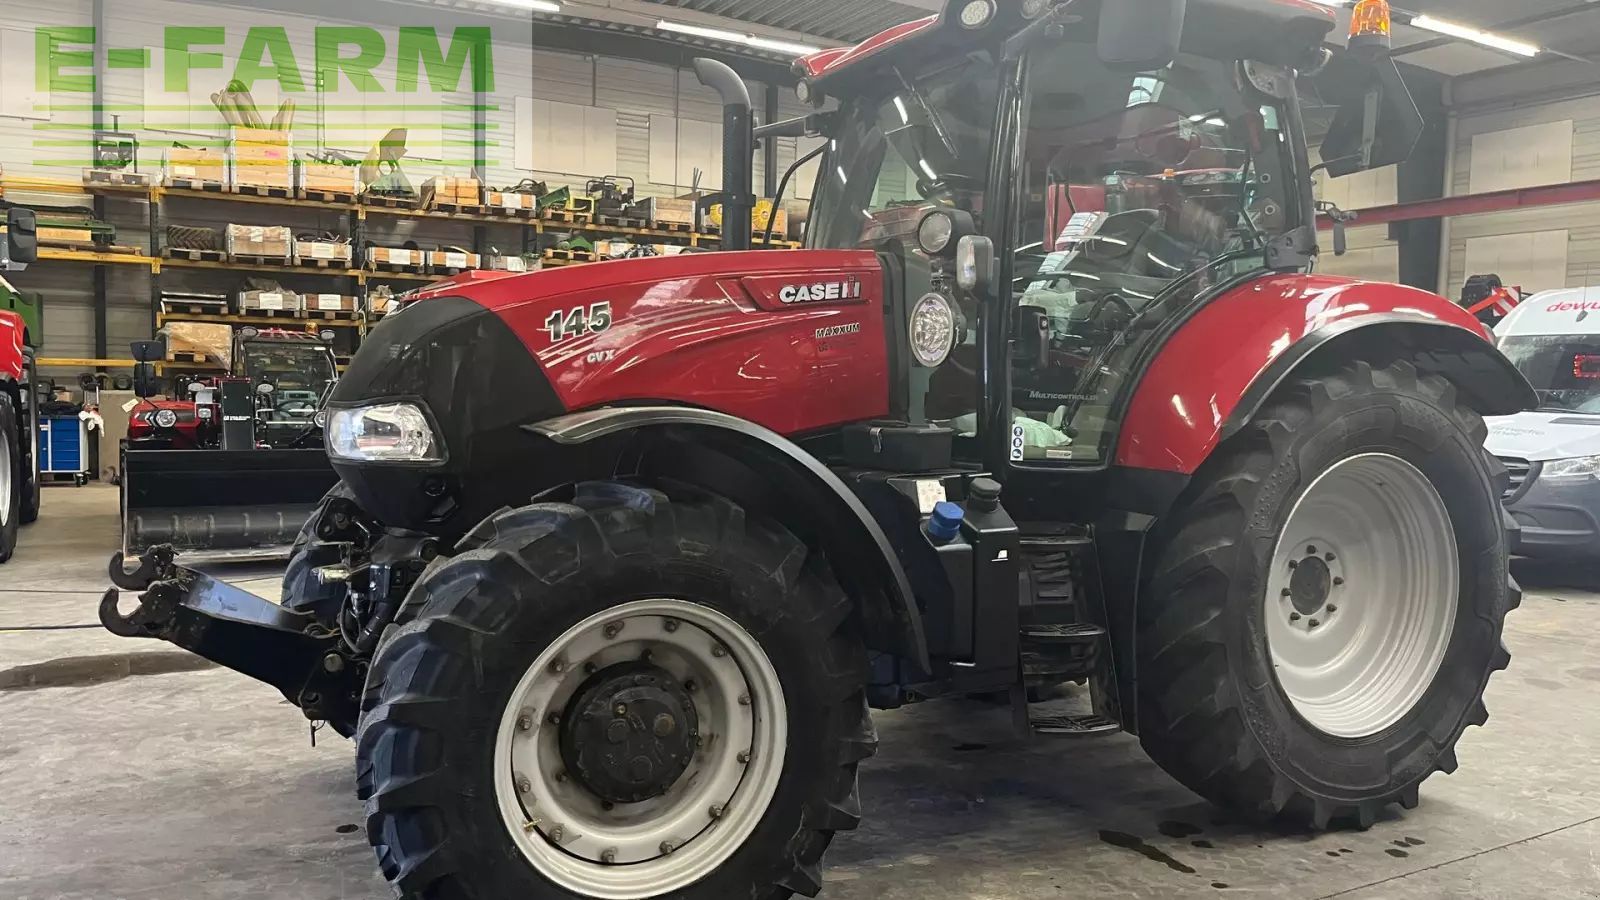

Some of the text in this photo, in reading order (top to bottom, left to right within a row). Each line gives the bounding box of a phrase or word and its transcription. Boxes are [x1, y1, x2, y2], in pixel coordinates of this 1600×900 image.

[779, 283, 840, 303] CASE
[544, 301, 612, 342] 145
[815, 322, 860, 339] MAXXUM
[587, 349, 616, 363] CVX
